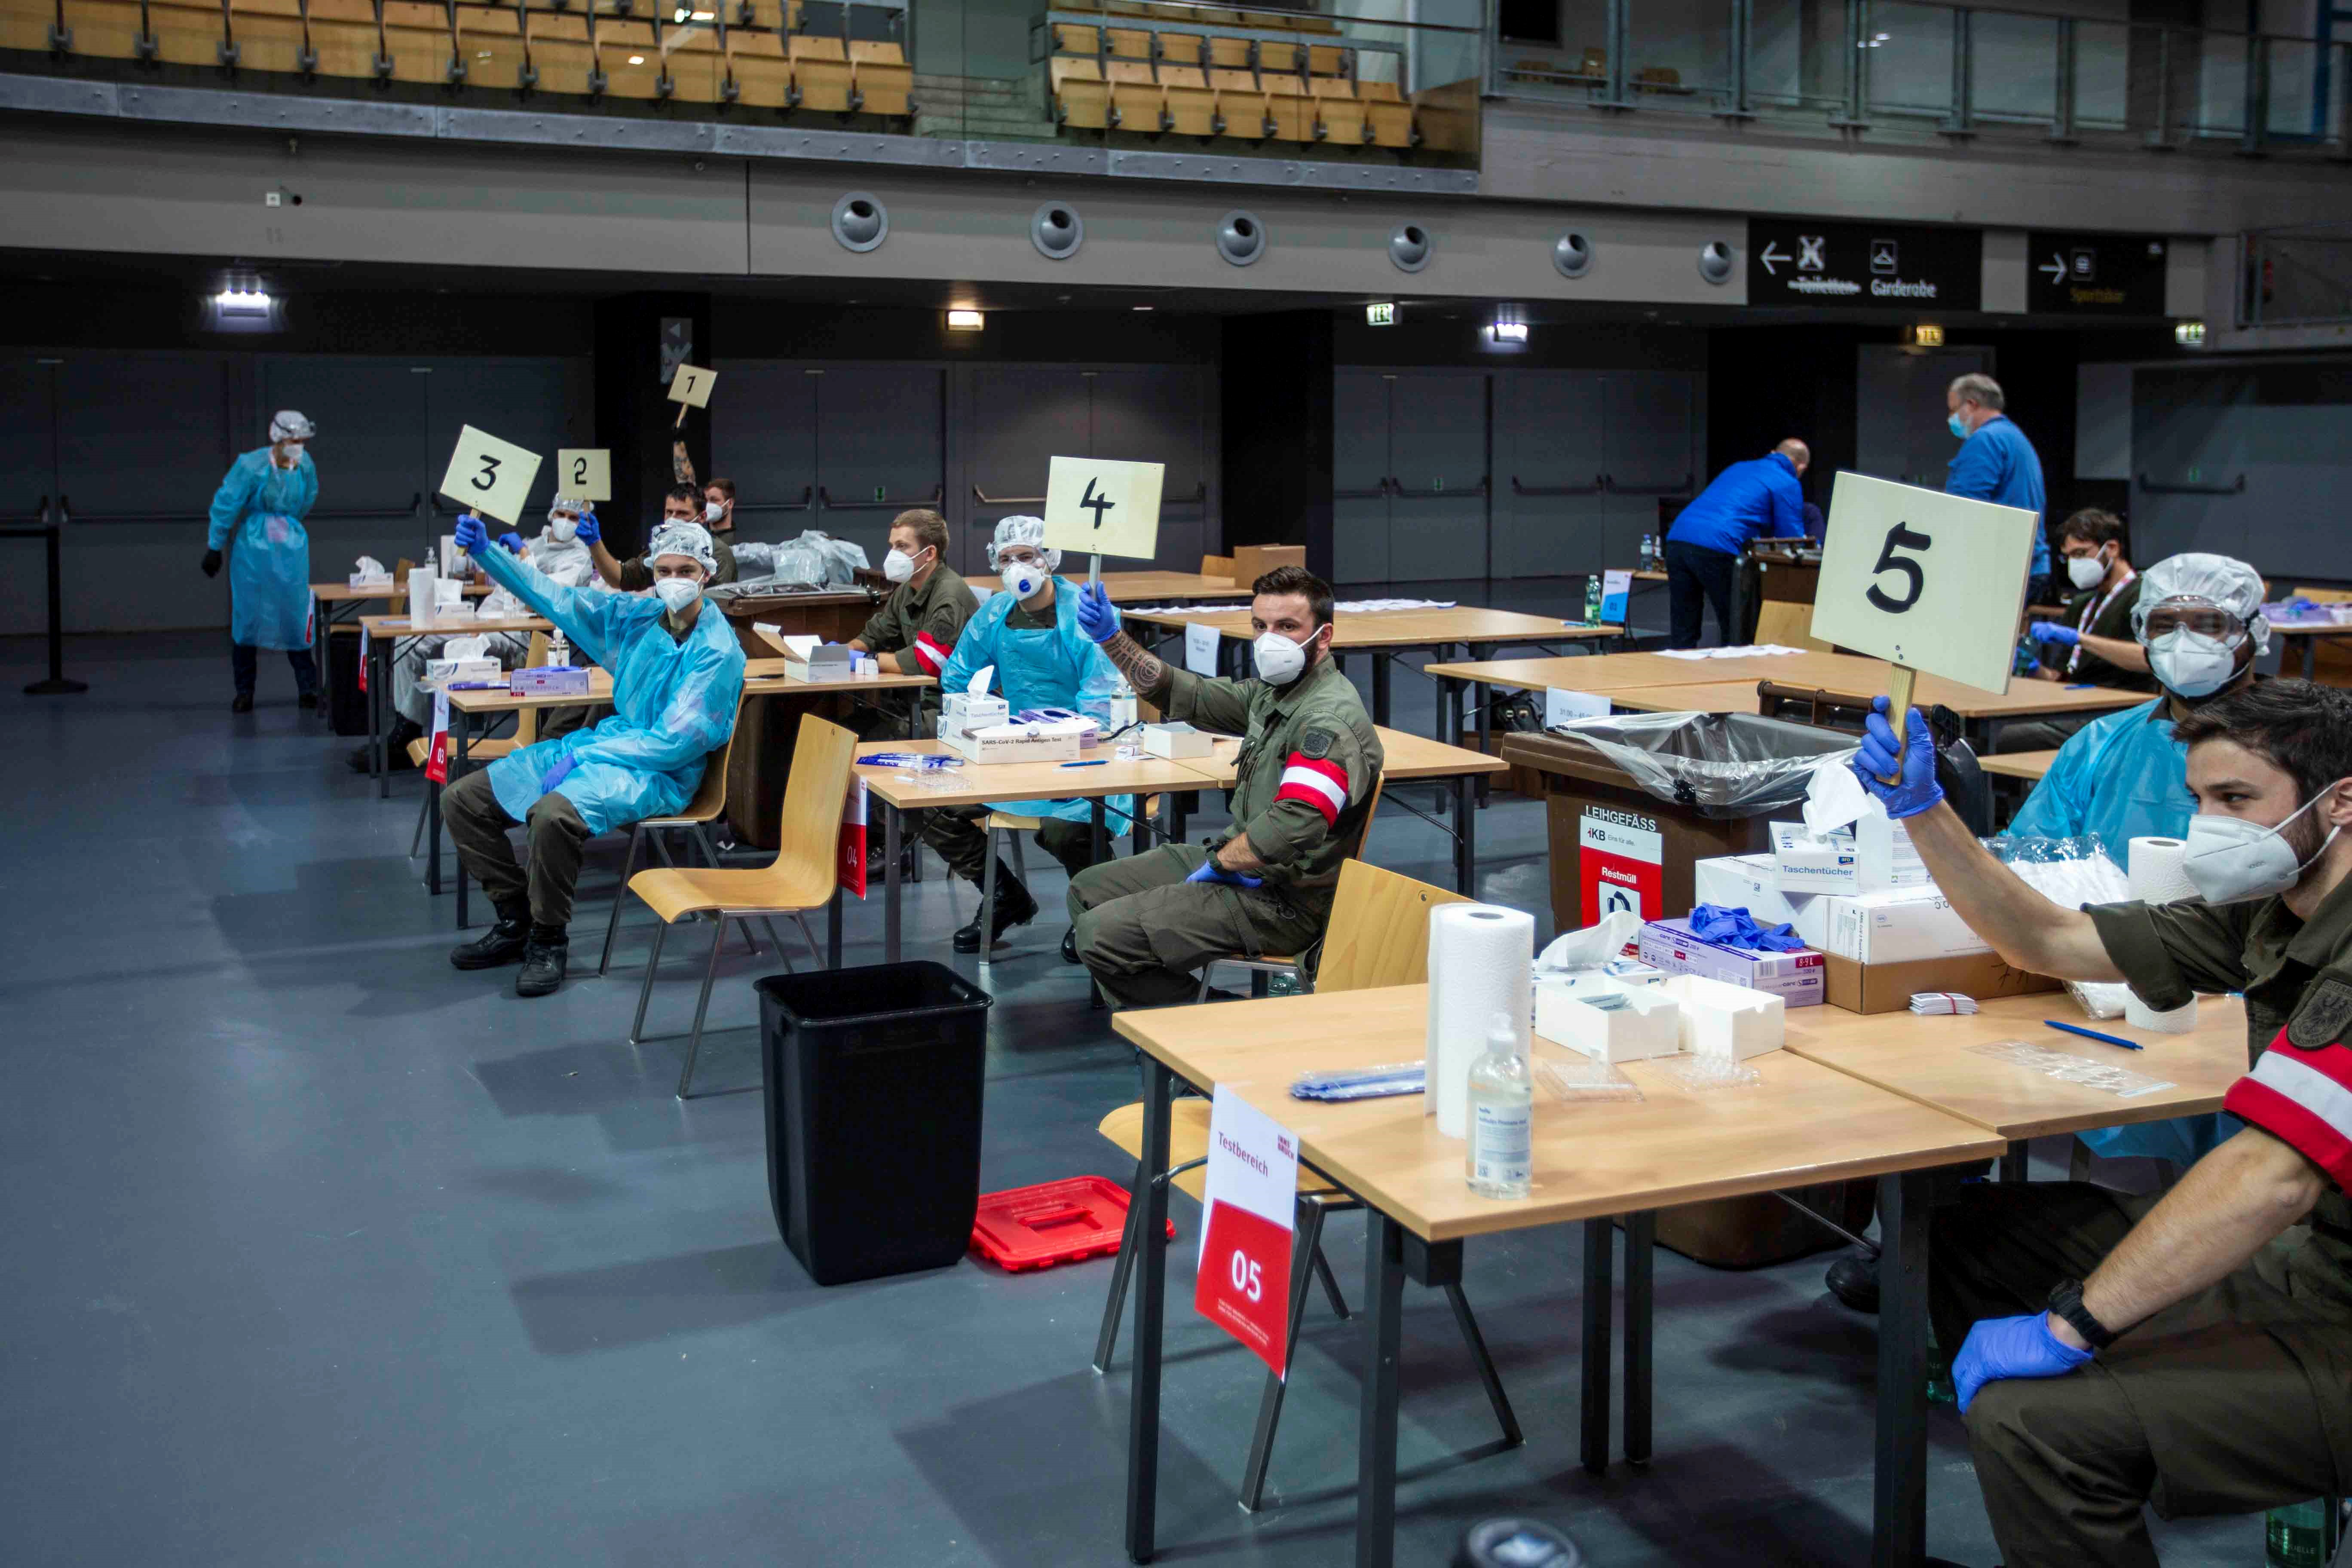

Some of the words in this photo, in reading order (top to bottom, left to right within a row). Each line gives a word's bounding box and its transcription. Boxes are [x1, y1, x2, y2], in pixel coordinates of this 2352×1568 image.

[1871, 278, 1938, 298] Garderobe
[687, 376, 696, 394] 1
[472, 455, 502, 491] 3
[574, 457, 587, 485] 2
[1080, 476, 1115, 530] 4
[1866, 521, 1931, 614] 5
[438, 747, 444, 764] 03
[1586, 805, 1656, 832] LEIHGEFÄSS
[847, 845, 858, 867] 04
[1602, 866, 1637, 884] Restmüll
[1782, 865, 1853, 876] Taschentücher
[1219, 1131, 1268, 1177] Testbereich
[1232, 1250, 1261, 1302] 05
